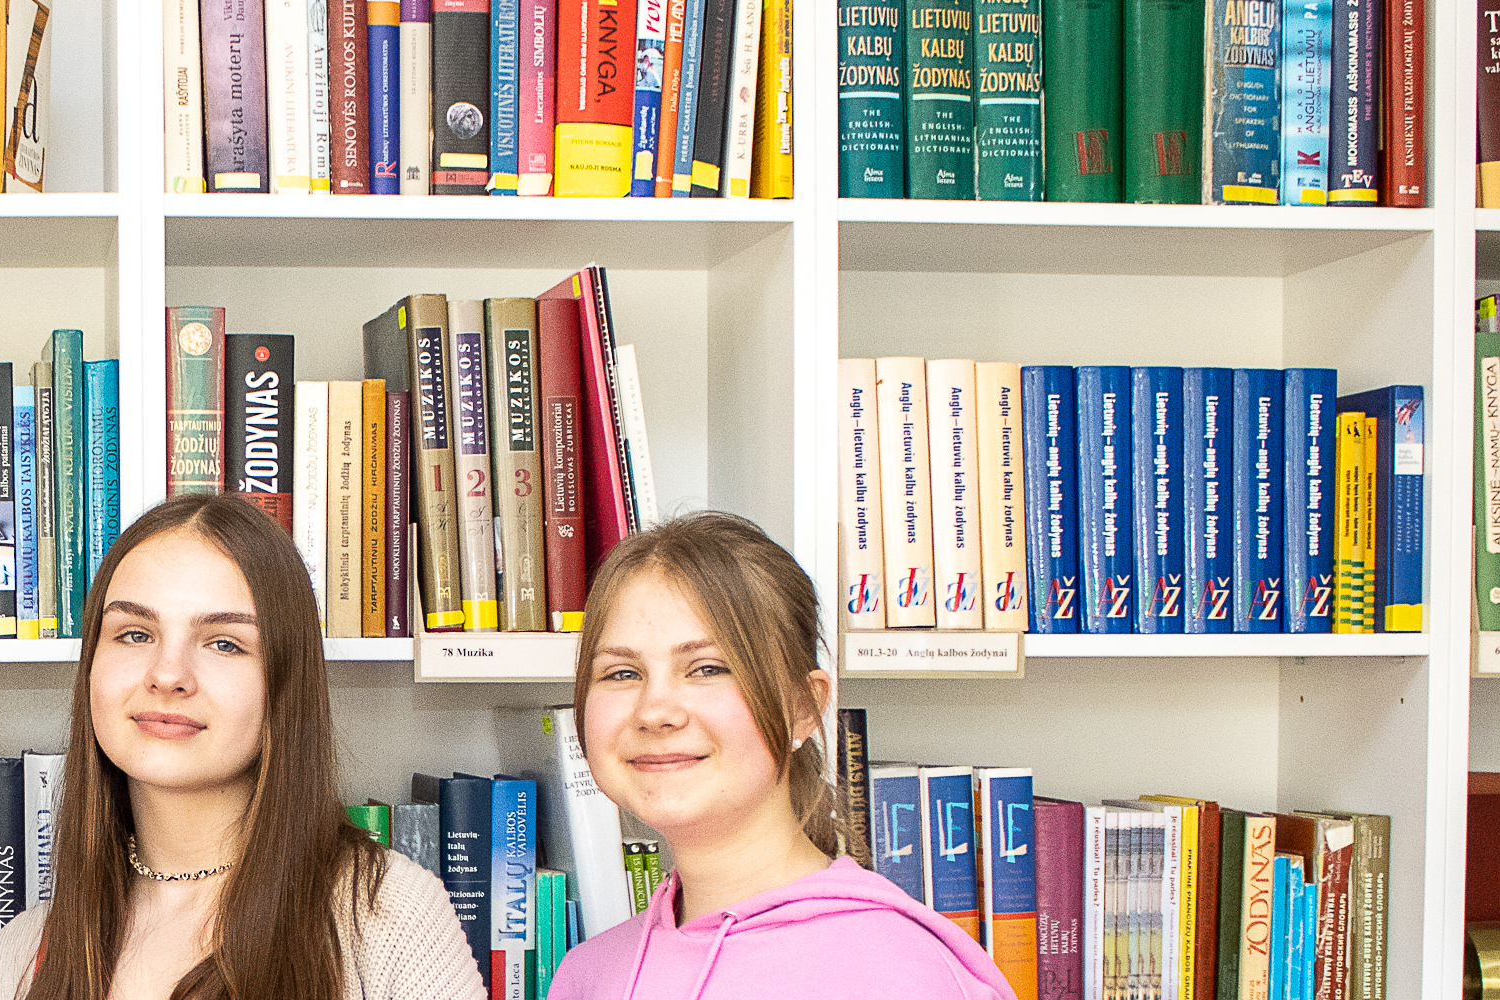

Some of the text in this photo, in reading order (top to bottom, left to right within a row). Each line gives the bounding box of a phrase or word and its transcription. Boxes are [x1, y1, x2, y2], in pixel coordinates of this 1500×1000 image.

[839, 6, 899, 32] LIETUVIŲ
[912, 8, 970, 34] LIETUVIŲ
[979, 14, 1039, 38] LIETUVIŲ
[1230, 27, 1270, 46] KALBOS
[228, 33, 245, 100] moterų
[534, 6, 547, 123] Literatūros SIMBOLIŲ
[848, 36, 892, 60] KALBŲ
[921, 38, 964, 64] KALBŲ
[988, 43, 1034, 67] KALBŲ
[840, 62, 900, 86] ŽODYNAS
[913, 63, 971, 88] ŽODYNAS
[980, 68, 1040, 92] ŽODYNAS
[1346, 12, 1358, 166] MOKOMASIS AIŠKINAMASIS
[342, 42, 358, 168] SENOVĖS ROMOS
[684, 91, 692, 131] CHARTIER
[1235, 118, 1265, 126] SPEAKERS
[1243, 106, 1257, 114] FOR
[738, 114, 748, 144] URBA
[842, 132, 900, 140] LITHUANIAN
[842, 144, 900, 152] DICTIONARY
[915, 134, 970, 143] LITHUANIAN
[1246, 130, 1254, 138] OF
[316, 131, 328, 178] Roma
[915, 146, 970, 154] DICTIONARY
[982, 150, 1040, 158] DICTIONARY
[417, 336, 436, 441] MUZIKOS
[458, 342, 476, 446] MUZIKOS
[508, 338, 524, 442] MUZIKOS
[1486, 363, 1498, 418] KNYGA
[170, 420, 222, 432] TARPTAUTINIŲ
[175, 434, 218, 457] ŽODŽIŲ
[239, 370, 279, 494] ŽODYNAS
[0, 425, 10, 498] kalbos patarimai
[62, 418, 74, 476] KULTŪRA
[368, 422, 378, 486] KIRČIAVIMAS
[552, 403, 566, 512] Lietuvių kompozitoriai
[20, 411, 32, 542] KALBOS TAISYKLĖS
[429, 464, 446, 492] 1
[466, 468, 486, 497] 2
[514, 468, 532, 497] 3
[568, 458, 576, 512] BOLESLOVAS
[855, 472, 865, 502] kalbų
[904, 466, 914, 496] kalbų
[392, 438, 402, 580] MOKYKLINIS TARPTAUTINIŲ ŽODŽIŲ
[857, 507, 868, 550] žodynas
[906, 501, 916, 544] žodynas
[953, 472, 966, 548] kalbų žodynas
[1004, 471, 1016, 547] kalbų žodynas
[340, 462, 352, 600] Mokyklinis tarptautinių žodžių
[1050, 514, 1064, 558] žodynas
[442, 648, 494, 656] 78 Muzika
[857, 648, 1008, 660] 801.3-20 Anglų kalbos žodynai
[847, 732, 864, 782] ATLAS
[506, 810, 516, 858] KALBOS
[514, 790, 527, 857] VADOVĖLIS
[633, 866, 648, 909] MINUČIŲ
[1246, 825, 1272, 956] ŽODYNAS
[1184, 890, 1192, 937] PRANCŪZŲ
[1337, 893, 1346, 931] СЛОВАРЬ
[511, 963, 520, 985] Leca
